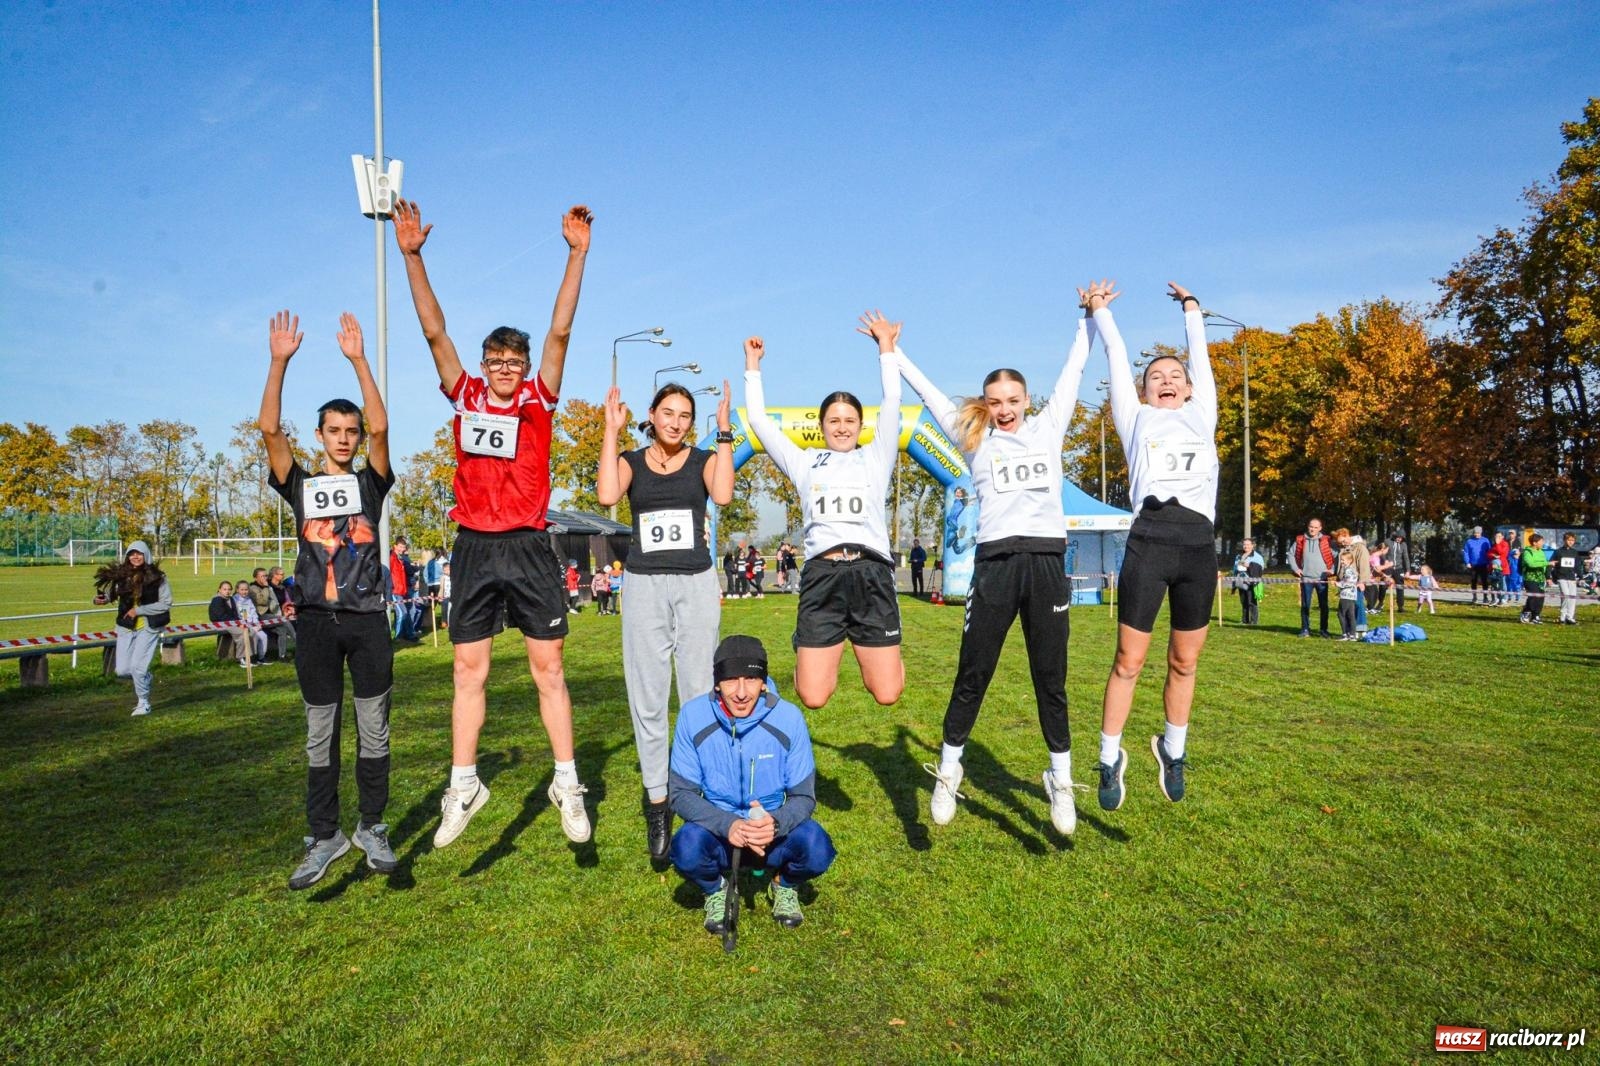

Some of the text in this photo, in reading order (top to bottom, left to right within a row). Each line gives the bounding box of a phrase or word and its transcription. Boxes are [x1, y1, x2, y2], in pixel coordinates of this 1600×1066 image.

[473, 427, 504, 449] 76
[914, 433, 962, 478] aktywnych
[1165, 452, 1196, 472] 97
[997, 462, 1048, 484] 109
[314, 489, 349, 509] 96
[815, 495, 863, 514] 110
[651, 524, 682, 543] 98
